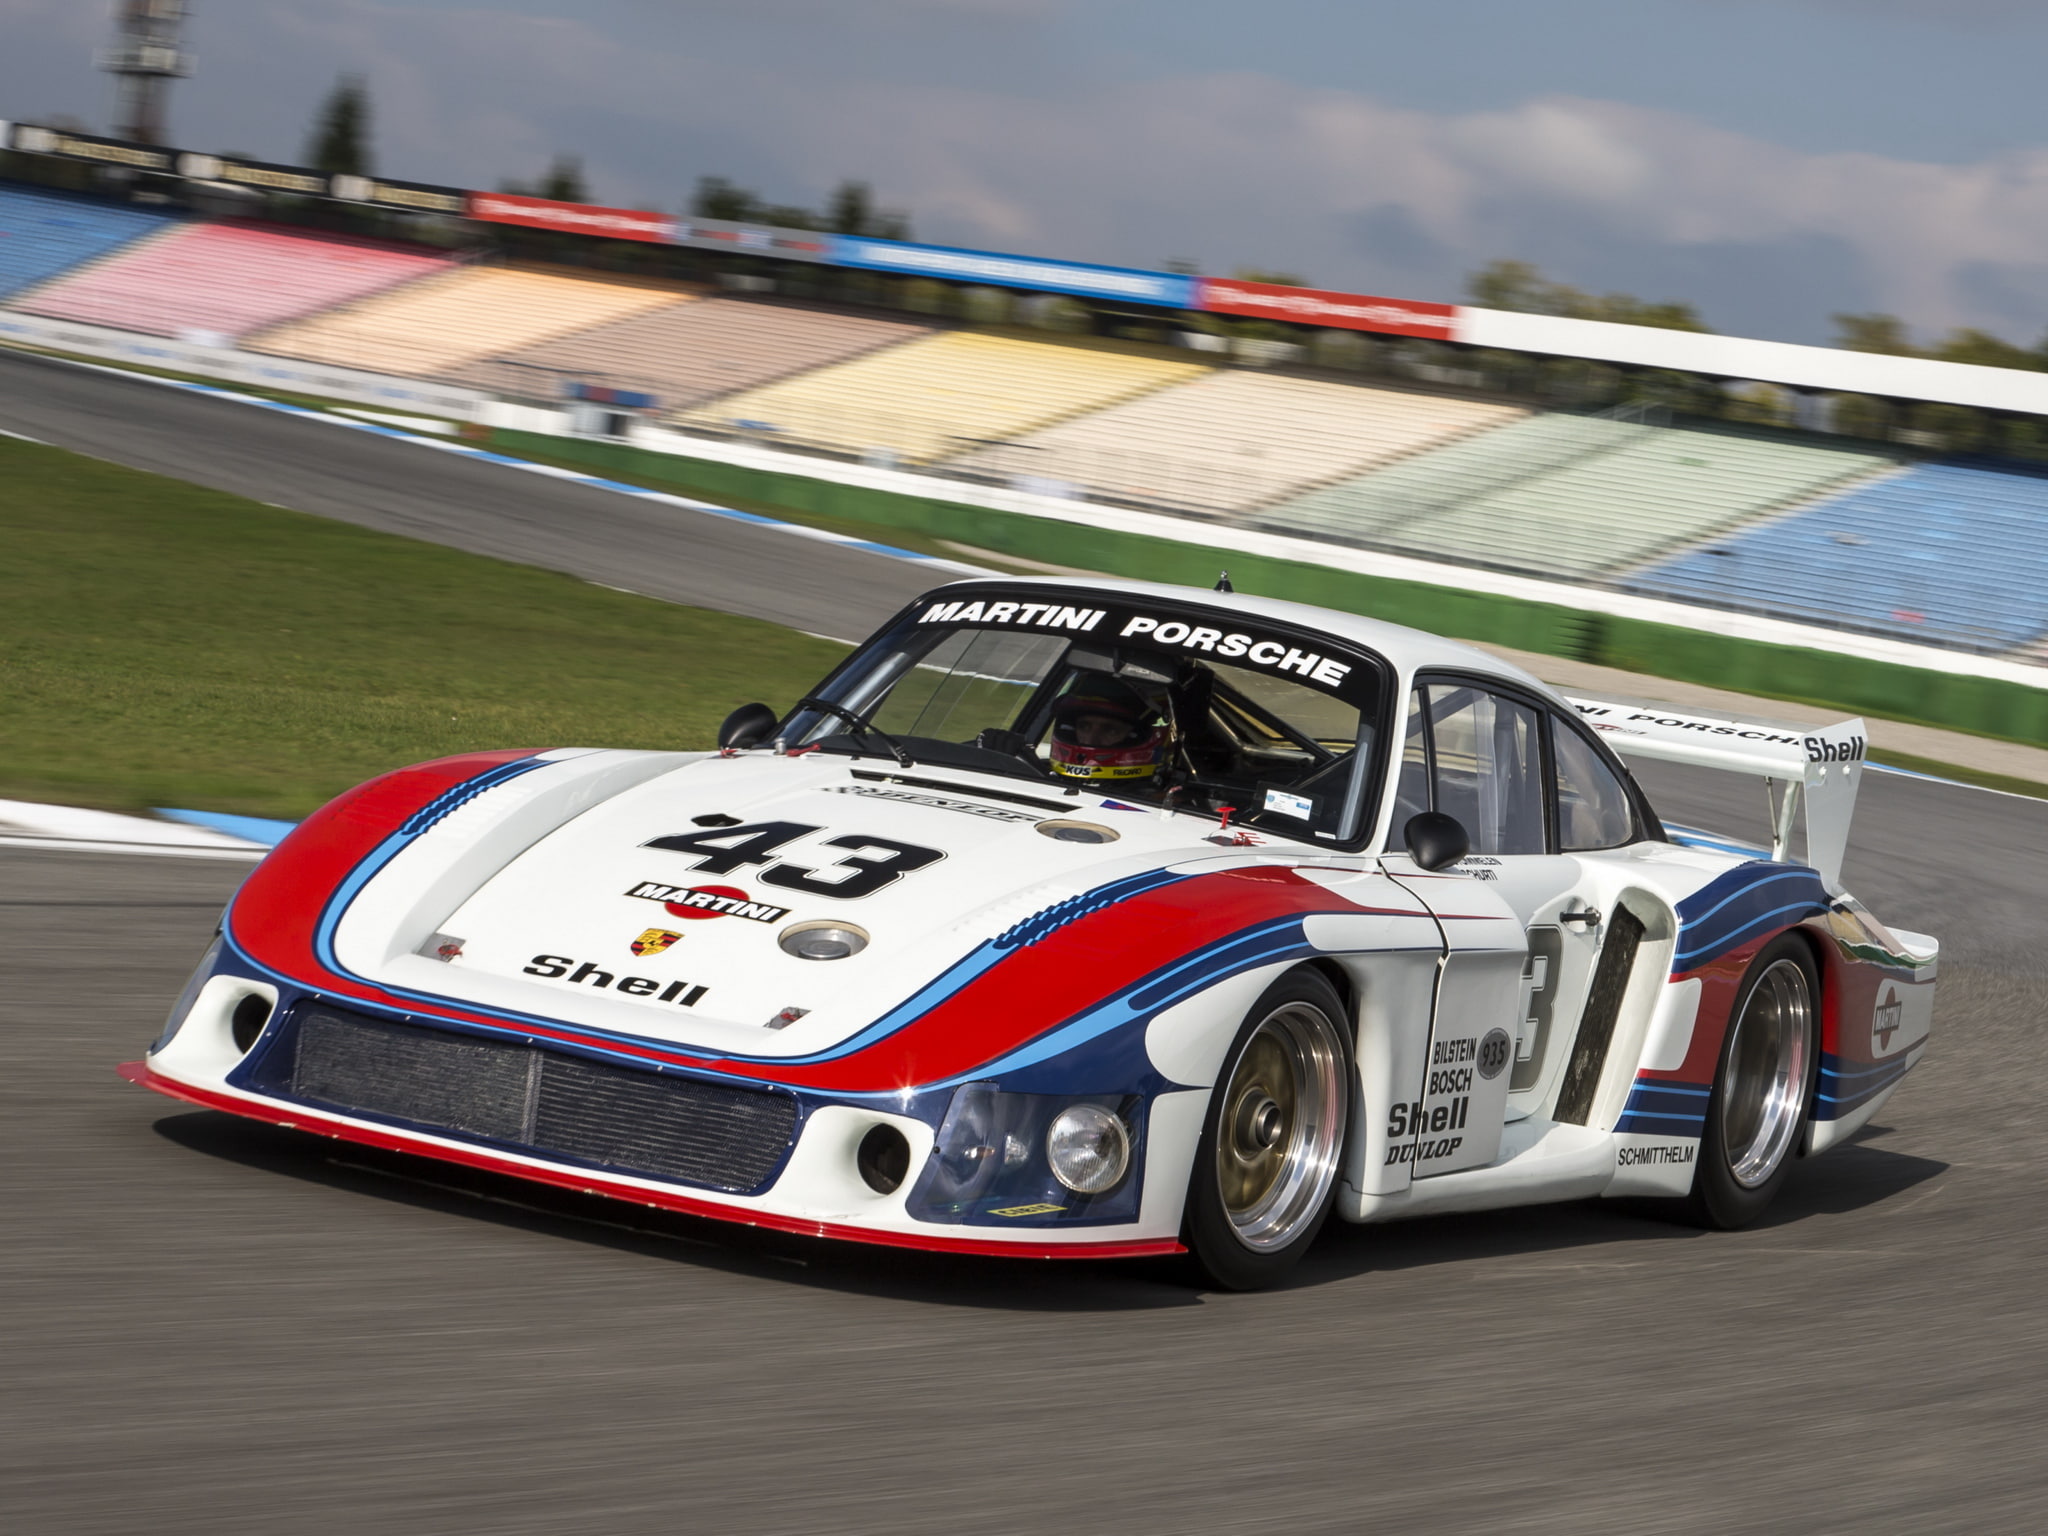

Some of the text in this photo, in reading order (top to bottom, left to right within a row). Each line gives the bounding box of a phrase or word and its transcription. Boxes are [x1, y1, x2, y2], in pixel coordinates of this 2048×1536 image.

[918, 601, 1351, 687] MARTINI PORSCHE
[1627, 713, 1800, 746] PORSCH
[1804, 736, 1864, 763] Shell
[637, 821, 949, 900] 43
[632, 883, 782, 922] MARTINI
[523, 954, 710, 1007] Shell
[1433, 1038, 1477, 1065] BILSTEIN
[1483, 1040, 1505, 1067] 935
[1429, 1068, 1473, 1095] BOSCH
[1387, 1096, 1469, 1138] Shell
[1384, 1137, 1463, 1166] DUNLOP
[1618, 1146, 1694, 1166] SCHMITTHELM
